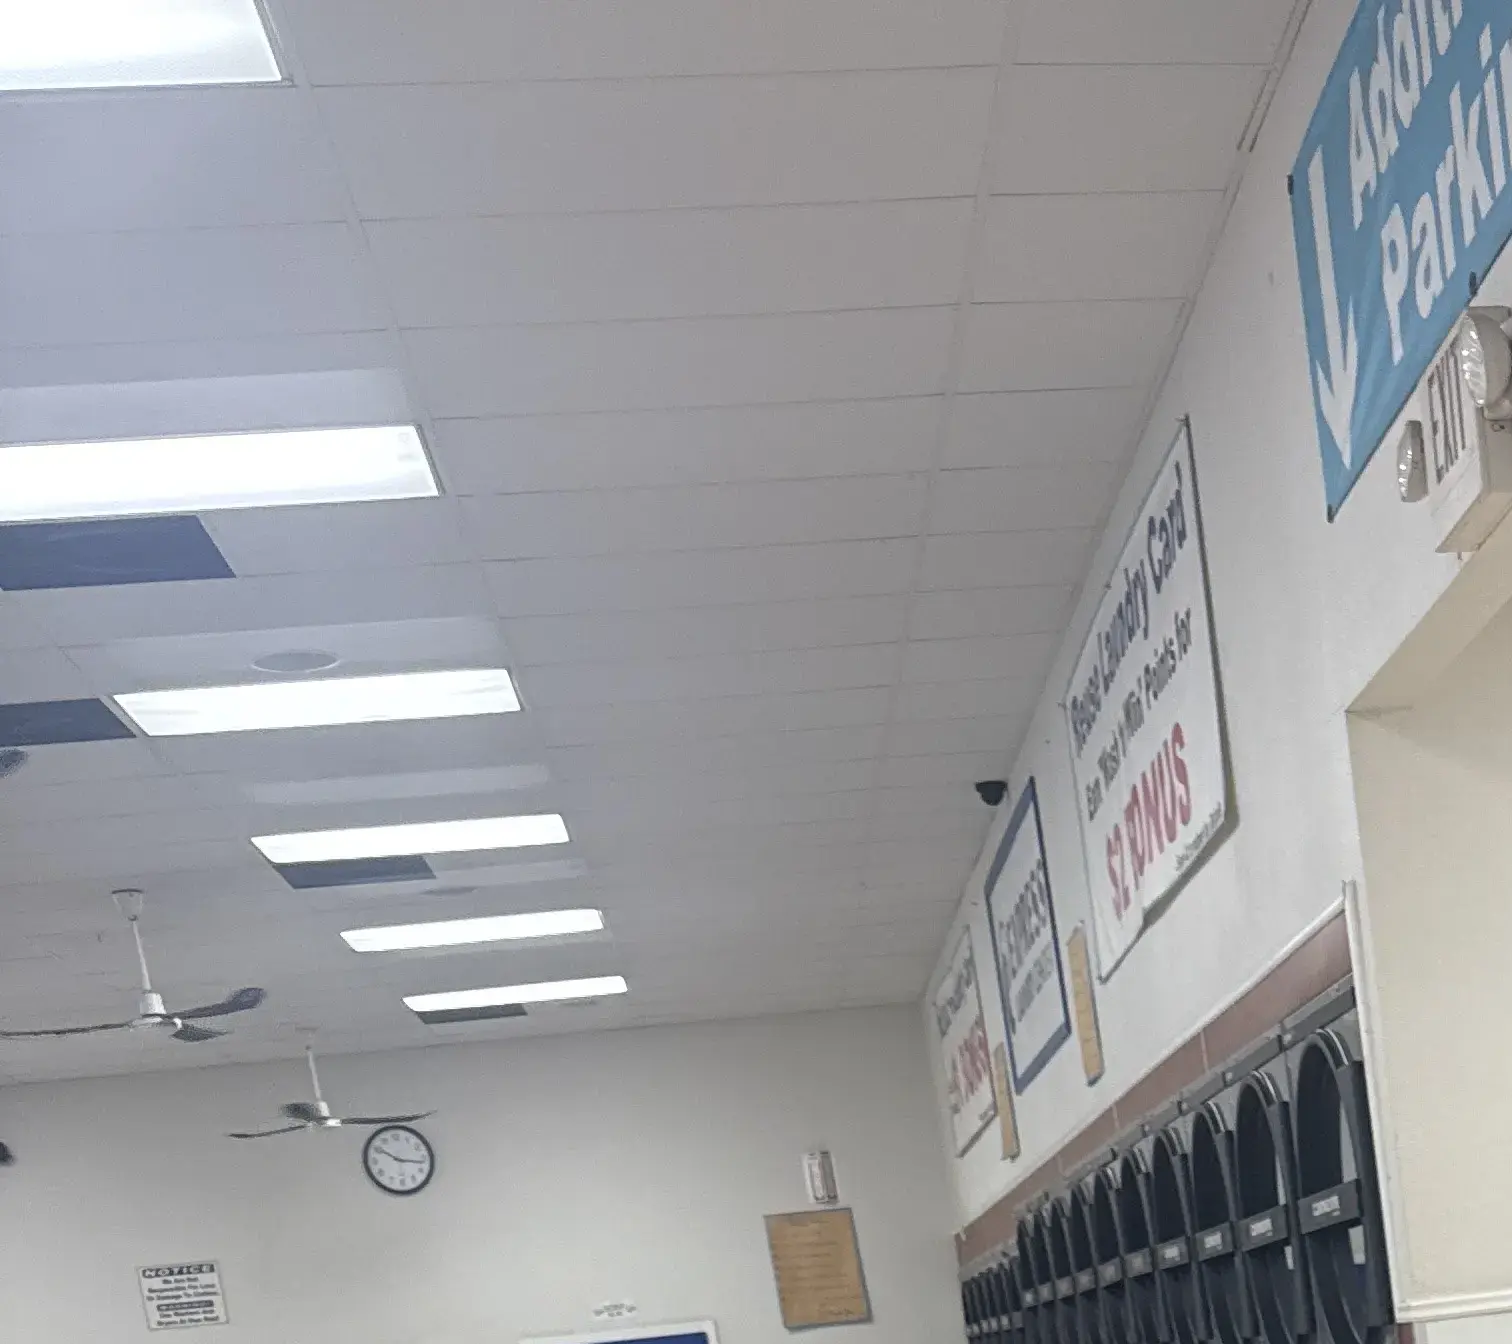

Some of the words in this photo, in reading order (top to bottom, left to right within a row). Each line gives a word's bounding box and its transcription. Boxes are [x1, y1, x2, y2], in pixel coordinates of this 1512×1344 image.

[1097, 559, 1149, 695] Laundry
[1148, 460, 1187, 594] Card
[145, 1265, 212, 1277] NOTICE
